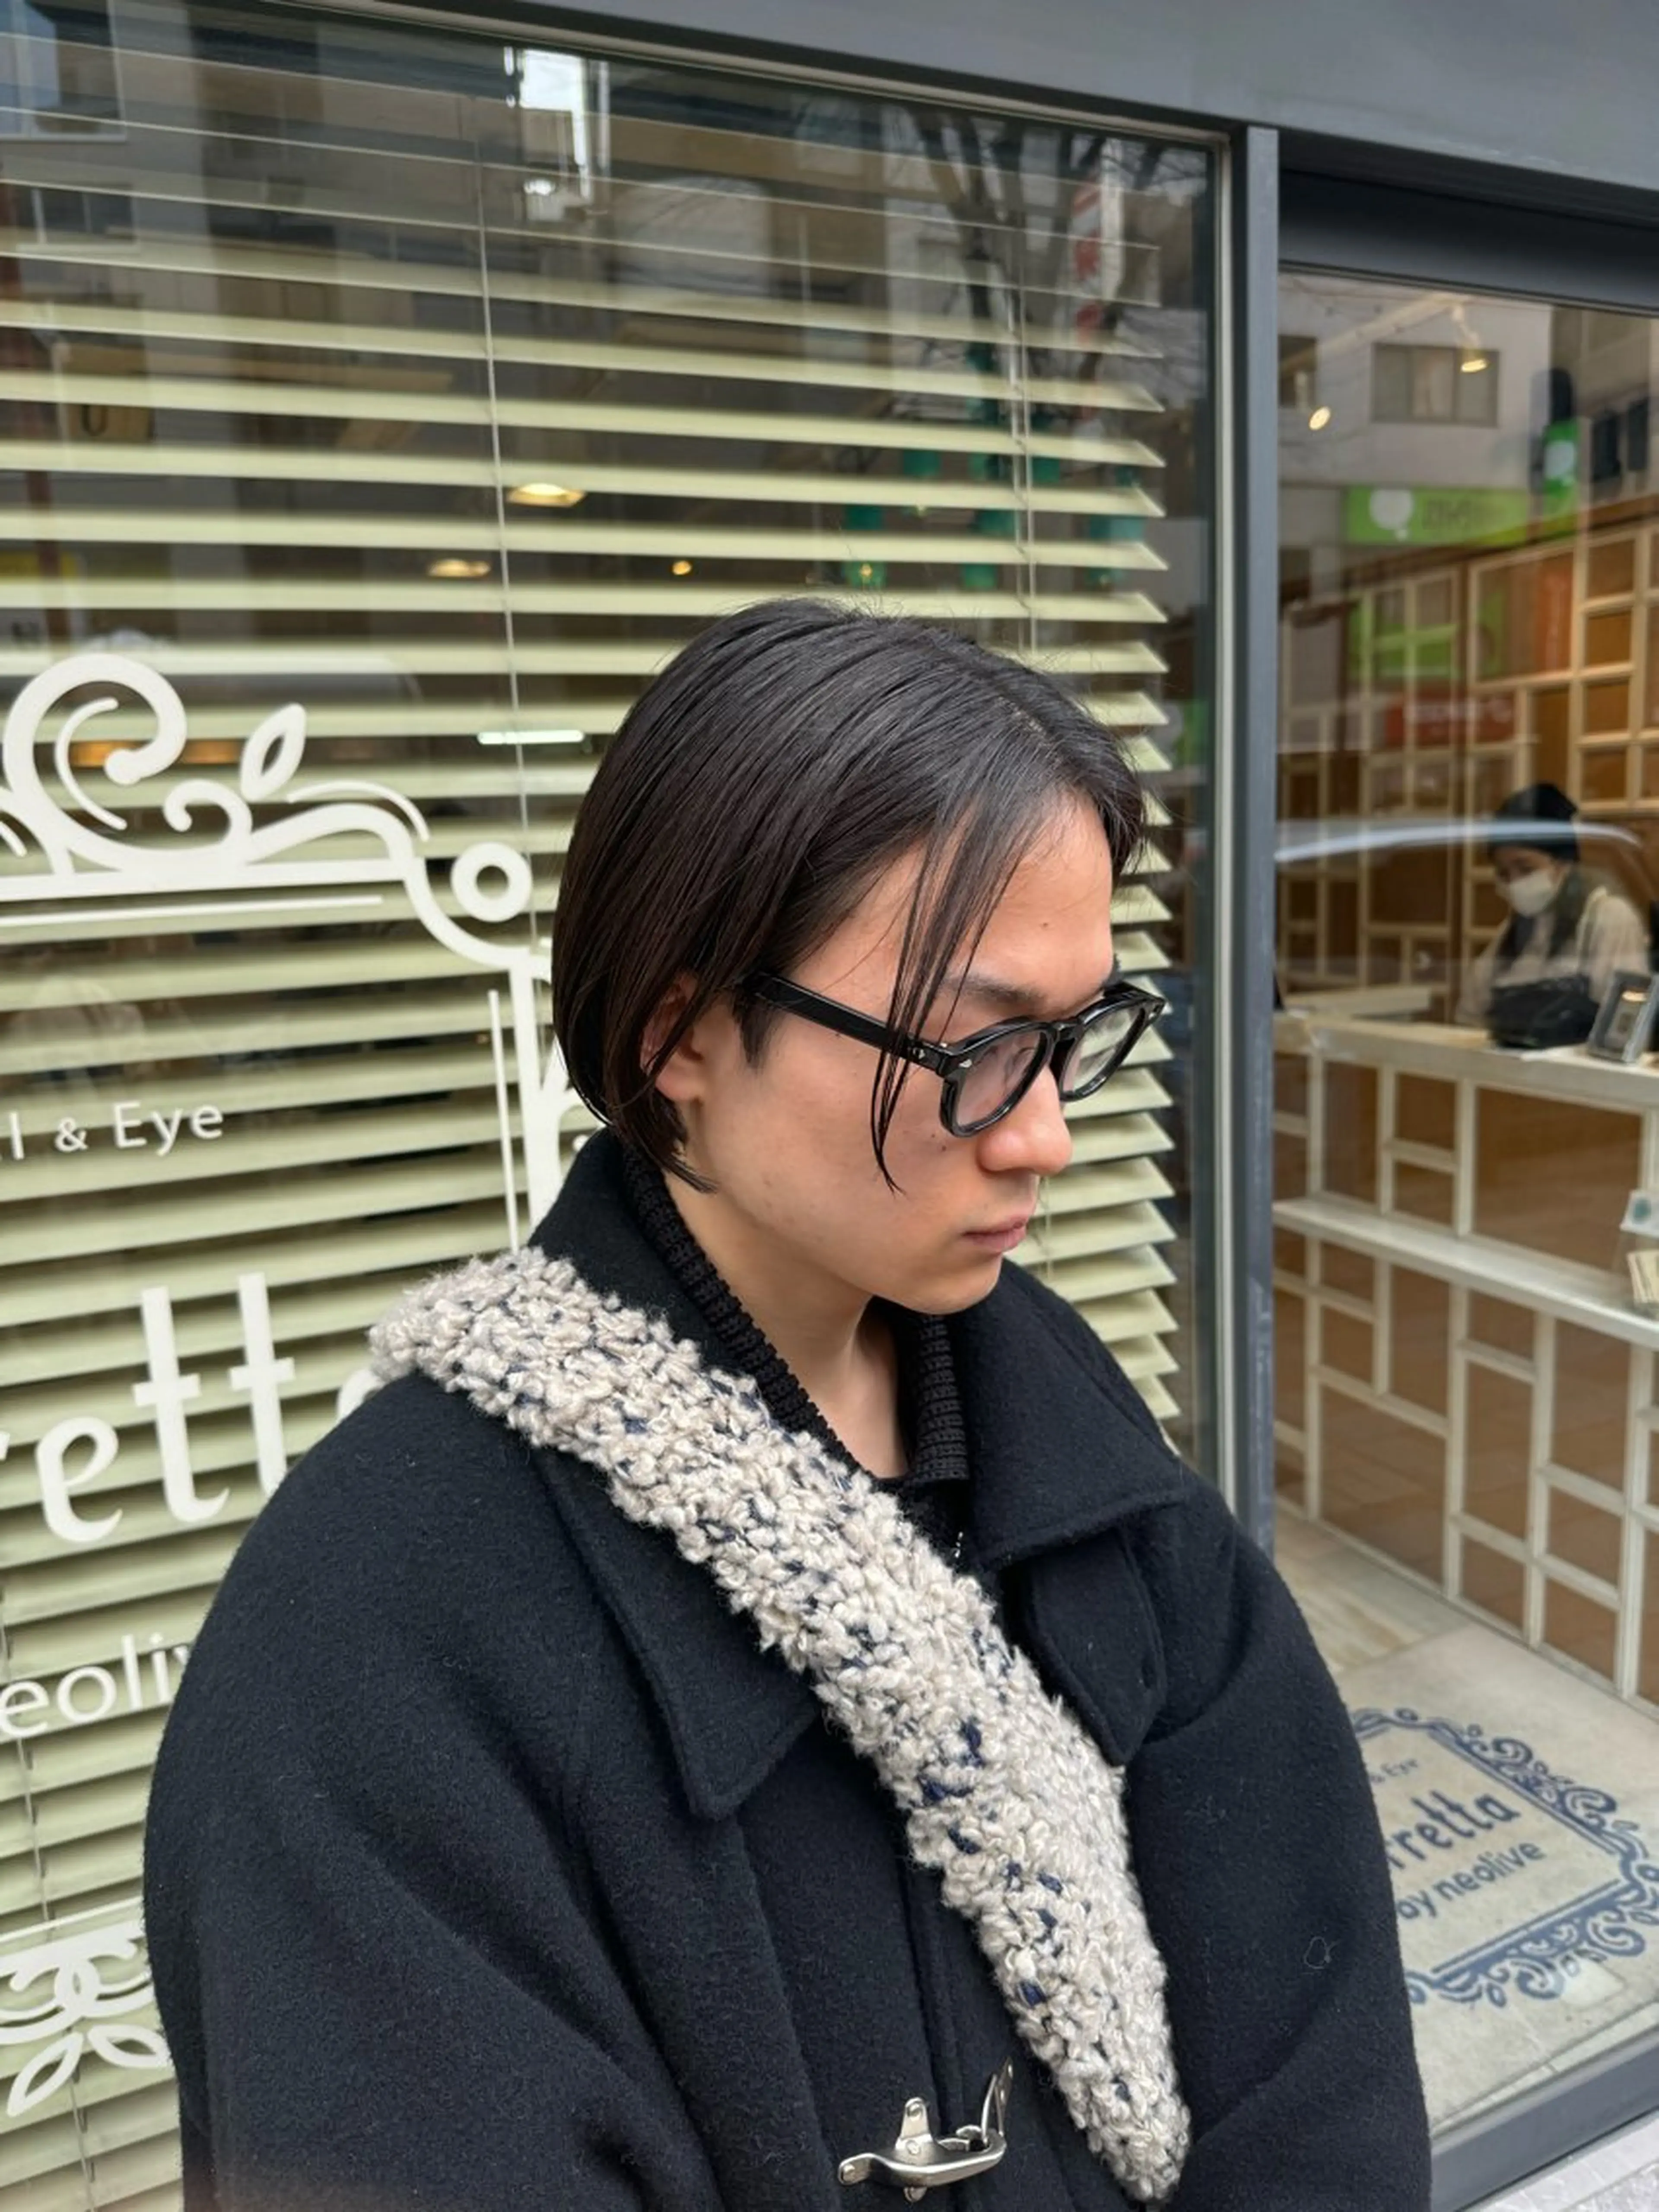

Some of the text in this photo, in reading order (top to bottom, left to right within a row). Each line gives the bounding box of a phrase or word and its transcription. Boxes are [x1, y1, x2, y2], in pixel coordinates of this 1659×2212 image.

[54, 1117, 88, 1152] &
[114, 1100, 224, 1157] Eye
[1433, 1842, 1547, 1902] neolive
